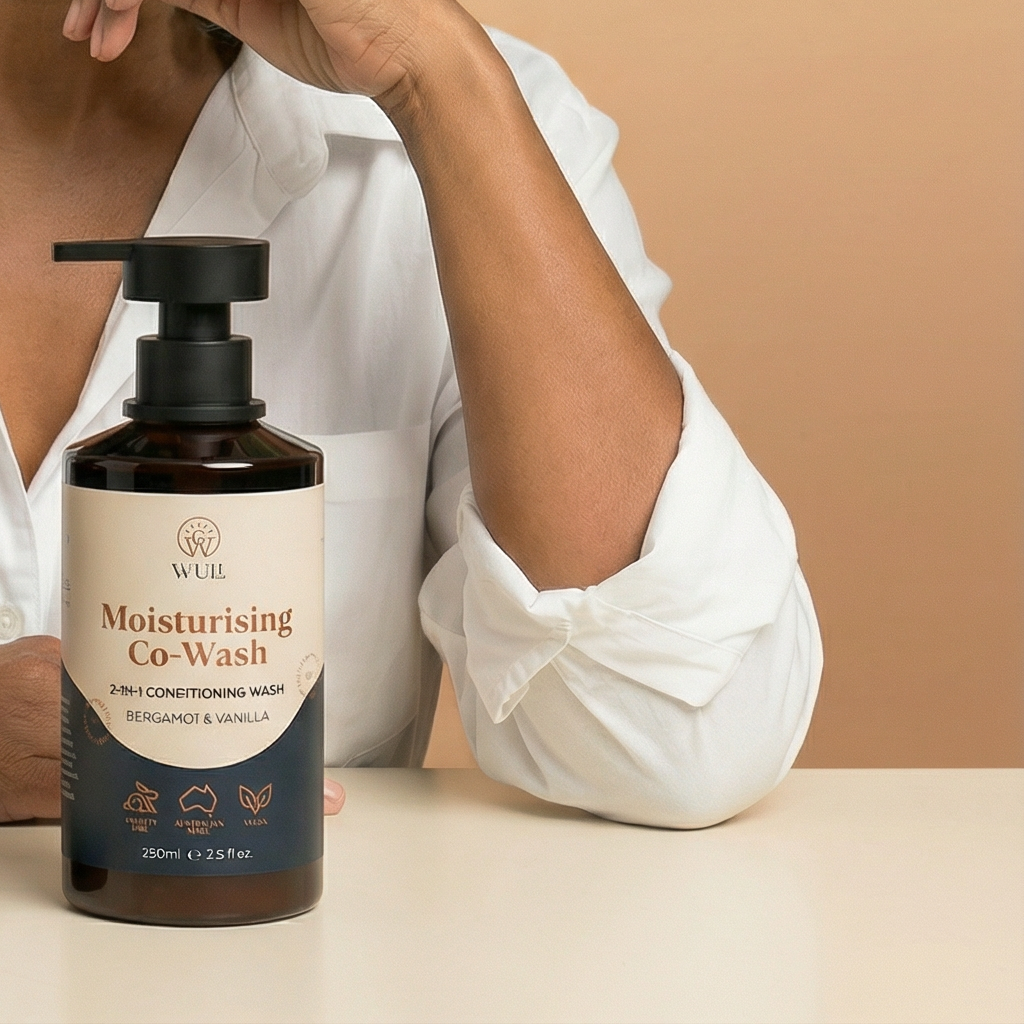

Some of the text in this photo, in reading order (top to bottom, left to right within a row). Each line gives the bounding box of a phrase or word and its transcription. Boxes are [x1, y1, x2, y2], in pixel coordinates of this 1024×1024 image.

[101, 603, 293, 638] Moisturising
[128, 639, 268, 667] Co-Wash
[249, 683, 285, 697] WASH
[126, 710, 270, 725] BERGAMOT & VANILLA
